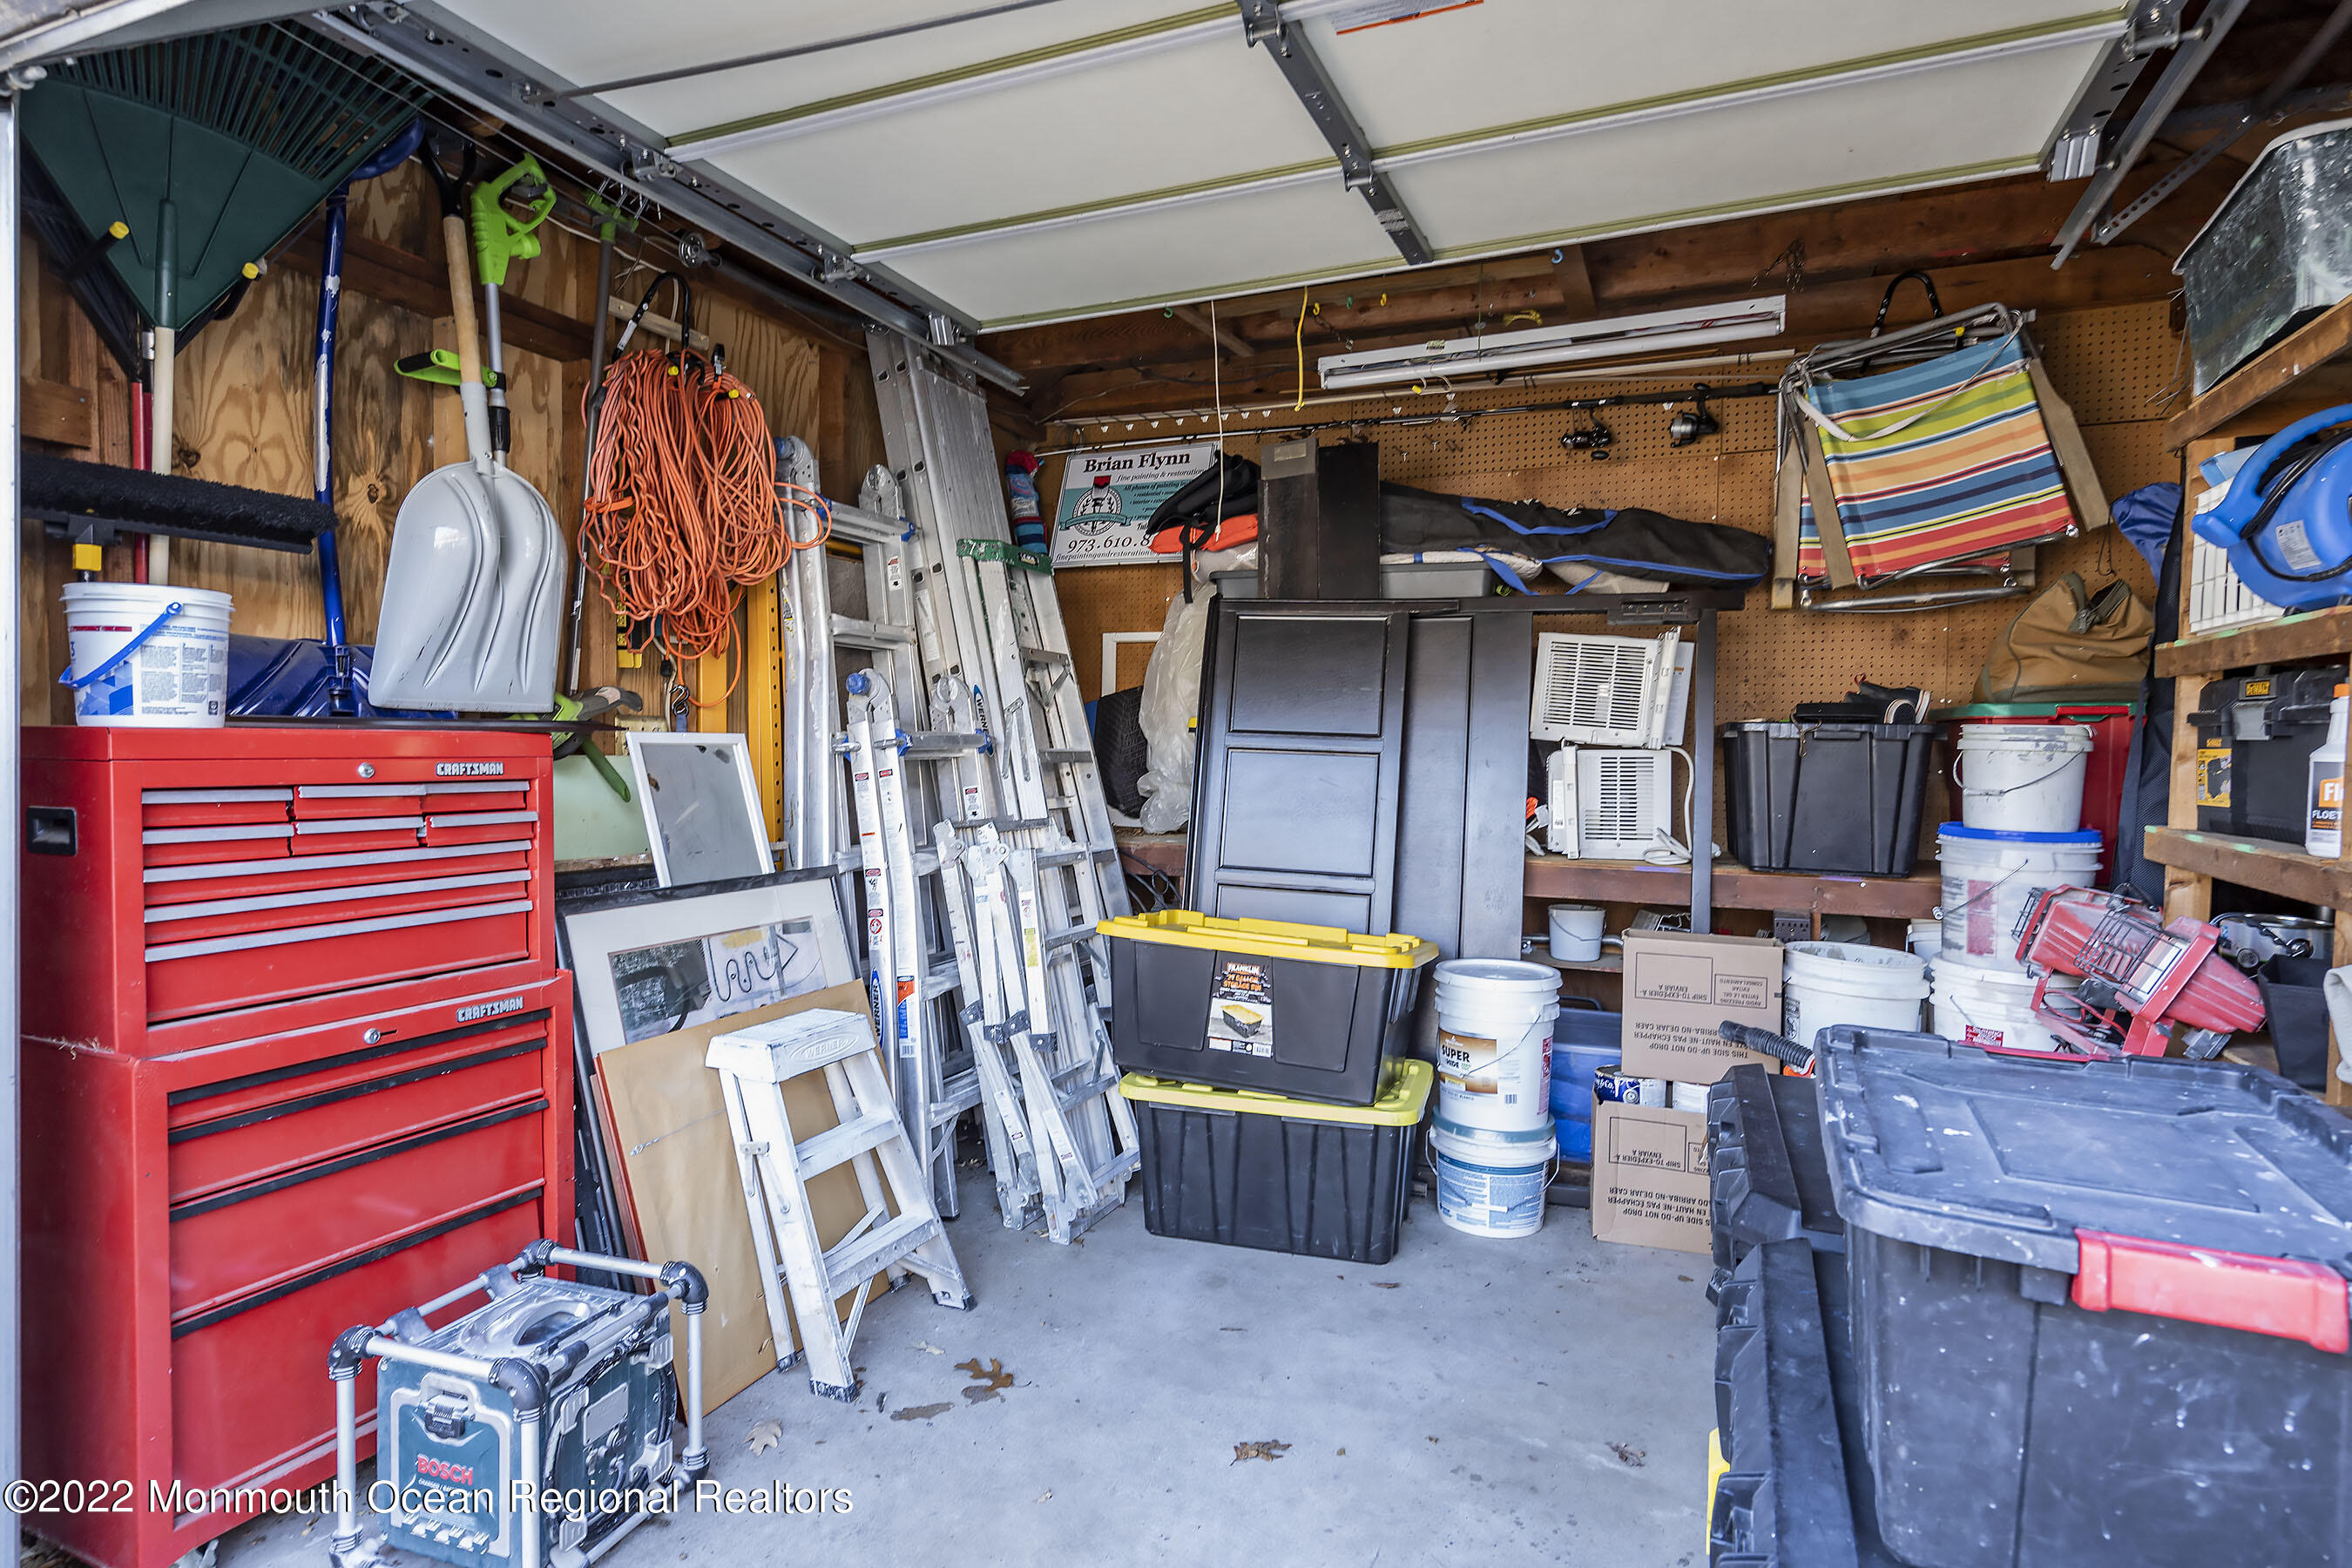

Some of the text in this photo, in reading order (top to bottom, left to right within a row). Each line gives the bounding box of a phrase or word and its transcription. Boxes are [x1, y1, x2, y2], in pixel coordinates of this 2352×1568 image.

[1083, 451, 1191, 473] Brian Flynn
[1117, 474, 1131, 483] fine
[1131, 471, 1159, 482] painting
[1067, 534, 1151, 554] 973.610.8
[1055, 549, 1151, 561] finepaintingandrestoration
[977, 699, 989, 734] WERNE
[436, 762, 504, 776] CRAFTSMAN
[2324, 782, 2344, 801] Fl
[2312, 809, 2342, 821] FLOET
[1227, 962, 1261, 976] FRANKLIN
[1223, 980, 1250, 990] STORAGE
[1236, 975, 1258, 983] GALLON
[456, 997, 524, 1023] CRAFTSMAN
[1656, 1024, 1680, 1032] DEJAR
[1681, 1026, 1718, 1036] RRIBA-NO
[1673, 1035, 1686, 1044] PAS
[1689, 1037, 1720, 1047] HAUT-NE
[806, 1037, 848, 1058] WERNER
[1649, 1043, 1669, 1051] DROP
[1687, 1045, 1711, 1055] UP-DO
[1442, 1044, 1470, 1063] SUPER
[1610, 1186, 1627, 1195] CAER
[1630, 1189, 1652, 1199] DEJAR
[1608, 1196, 1644, 1208] ÉCHAPPER
[1655, 1193, 1696, 1205] ARRIBA-NO
[1663, 1203, 1694, 1214] HAUT-NE
[1645, 1211, 1659, 1220] NOT
[1661, 1213, 1684, 1222] UP-DO
[1686, 1216, 1703, 1226] SIDE
[417, 1454, 474, 1486] BOSCH
